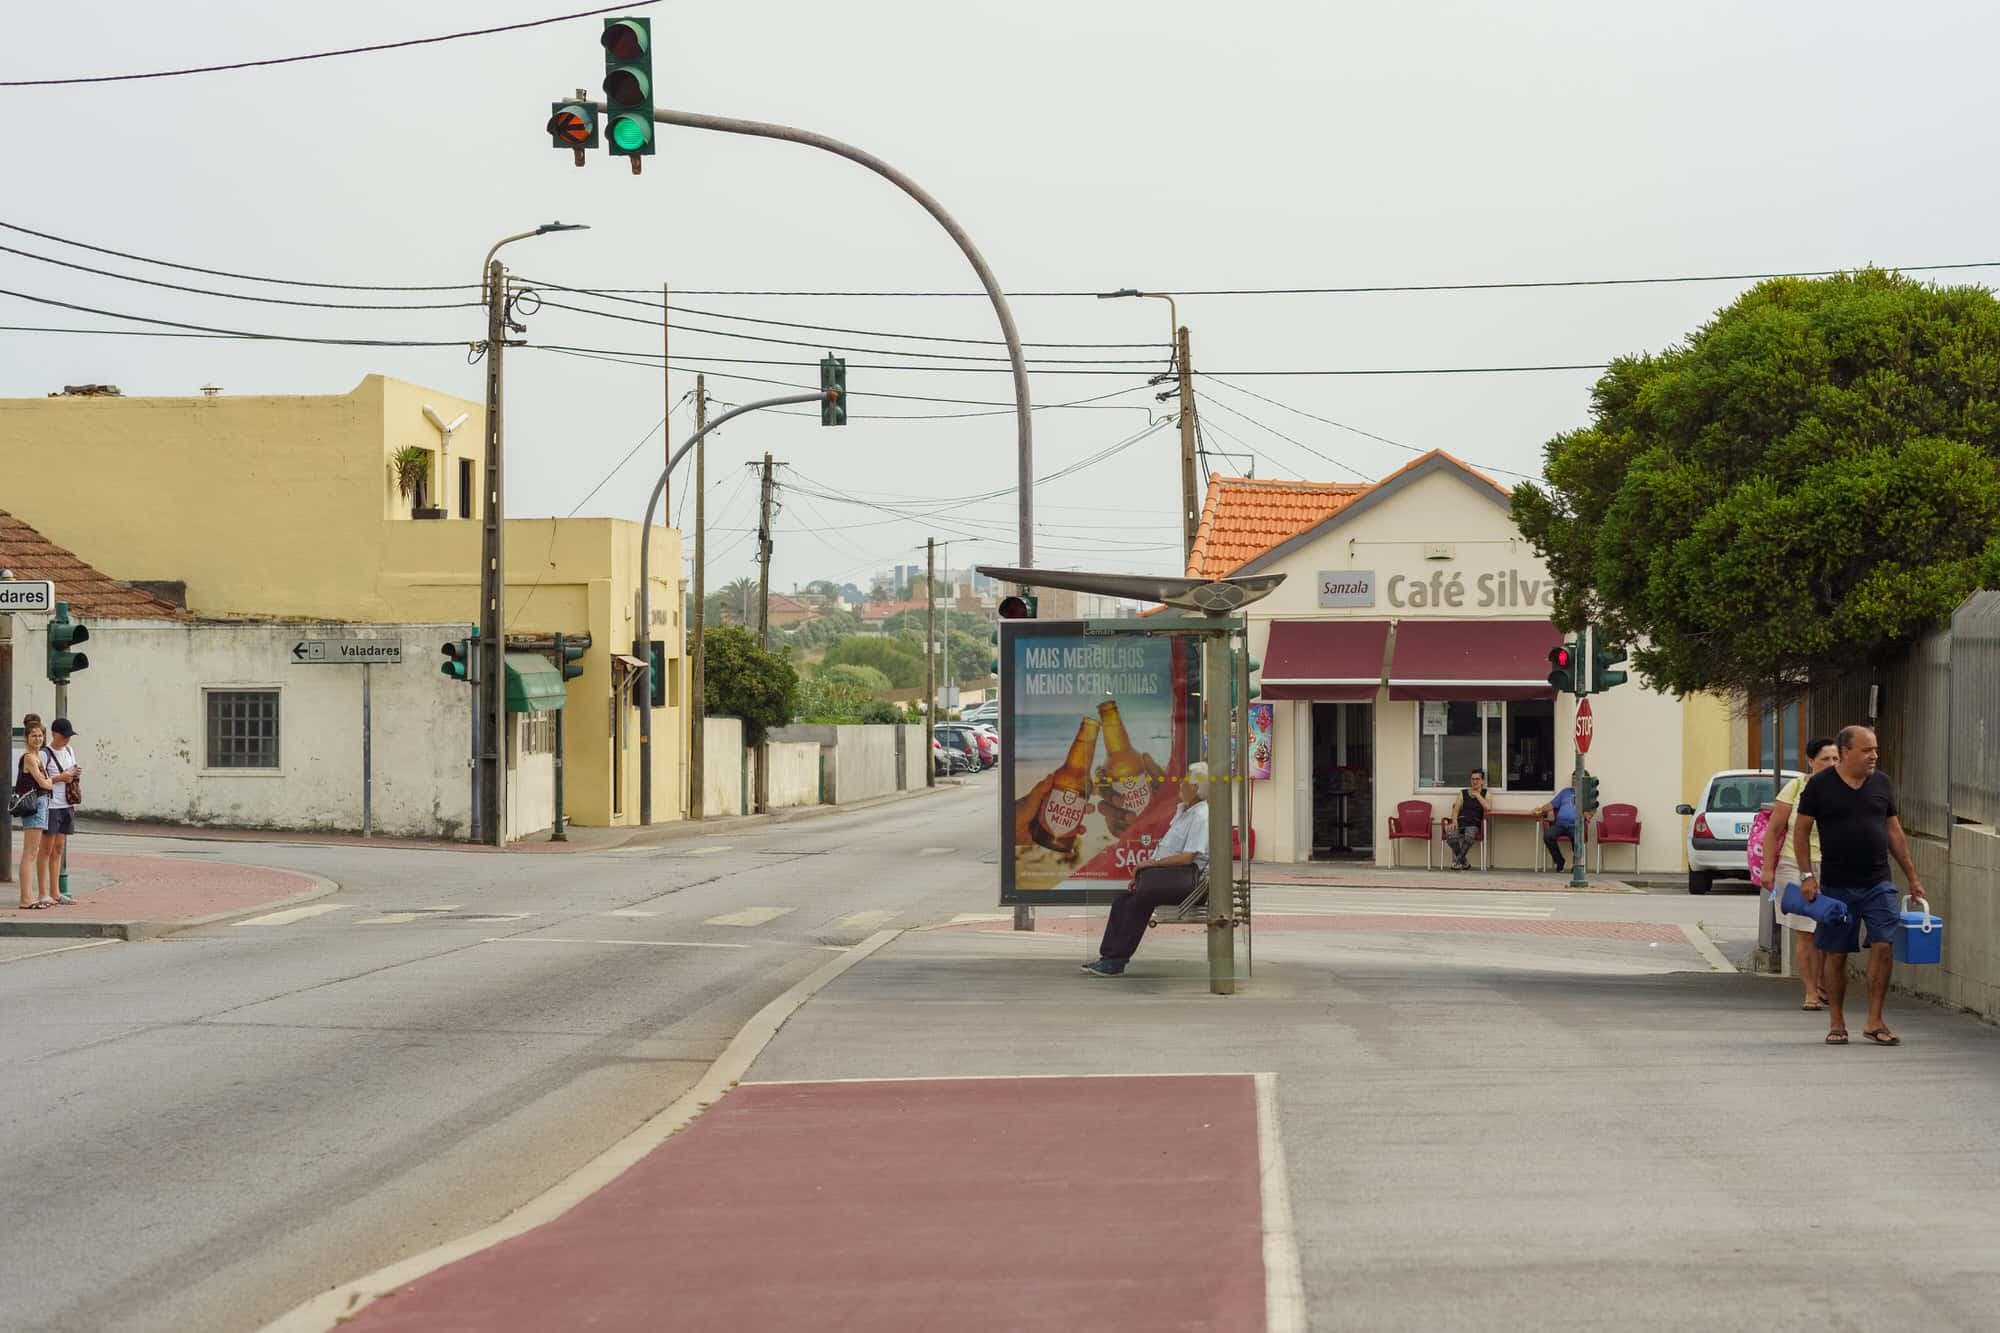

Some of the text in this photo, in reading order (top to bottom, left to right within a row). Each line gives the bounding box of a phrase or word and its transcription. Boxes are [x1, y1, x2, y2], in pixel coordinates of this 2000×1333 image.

[0, 589, 45, 603] dares
[1323, 581, 1369, 595] Sanzala
[1387, 569, 1556, 608] Café Silva
[340, 645, 400, 656] Valadares
[1025, 647, 1145, 669] MAIS MERGULHOS
[1025, 670, 1159, 695] MENOS CERIMÓNIAS
[1576, 716, 1592, 736] STOP
[1047, 801, 1082, 821] SAGRES
